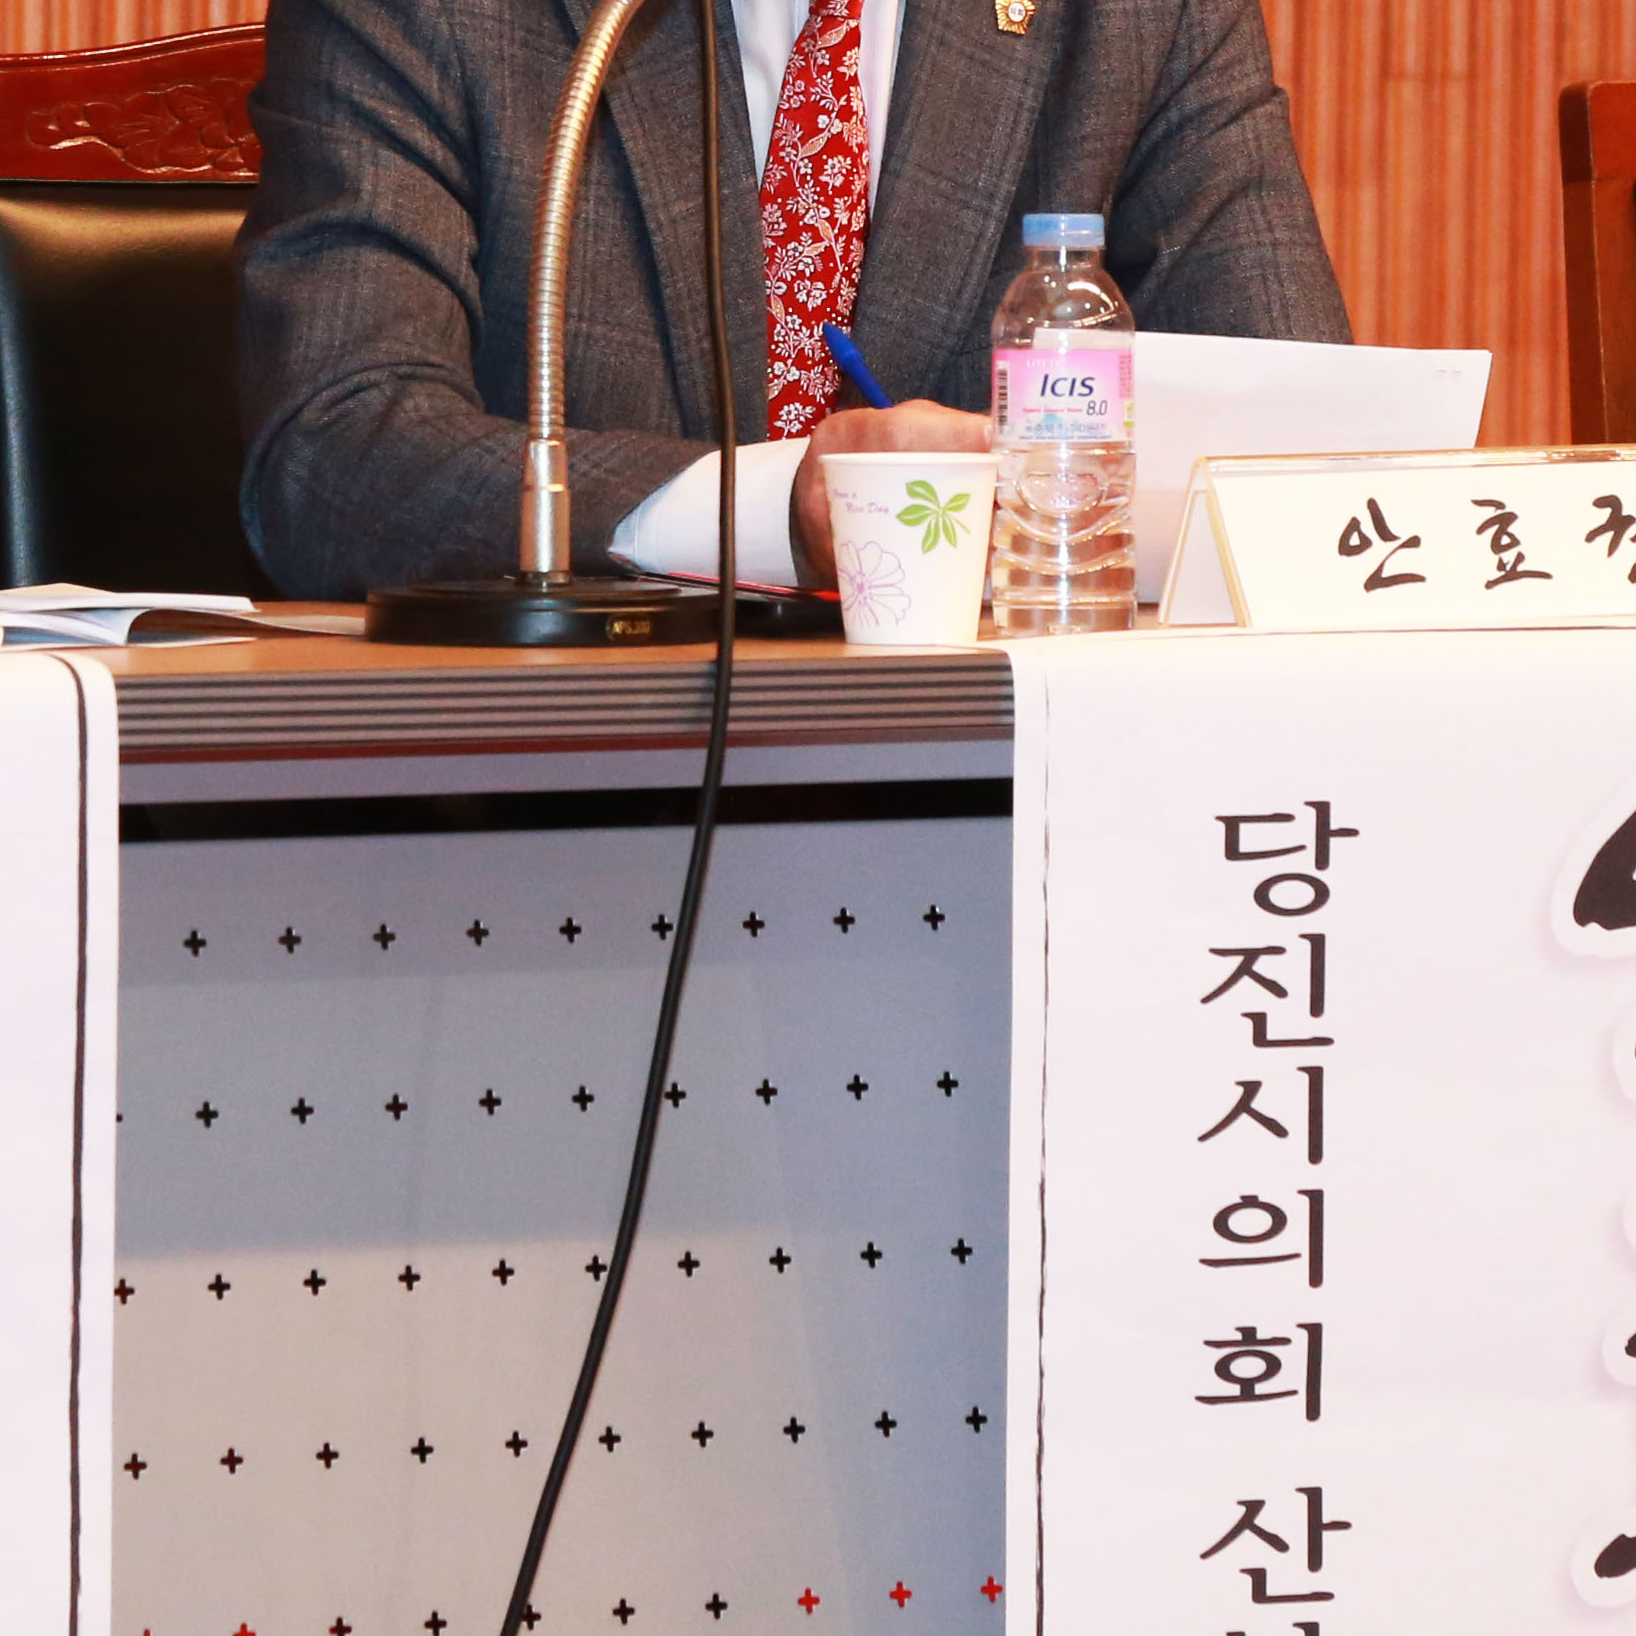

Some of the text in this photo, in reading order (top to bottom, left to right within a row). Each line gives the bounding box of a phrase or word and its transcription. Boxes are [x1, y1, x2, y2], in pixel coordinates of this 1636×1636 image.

[1040, 373, 1095, 397] ICIS
[1086, 400, 1108, 416] 8.0
[1194, 800, 1360, 1636] 당진시의회 산
